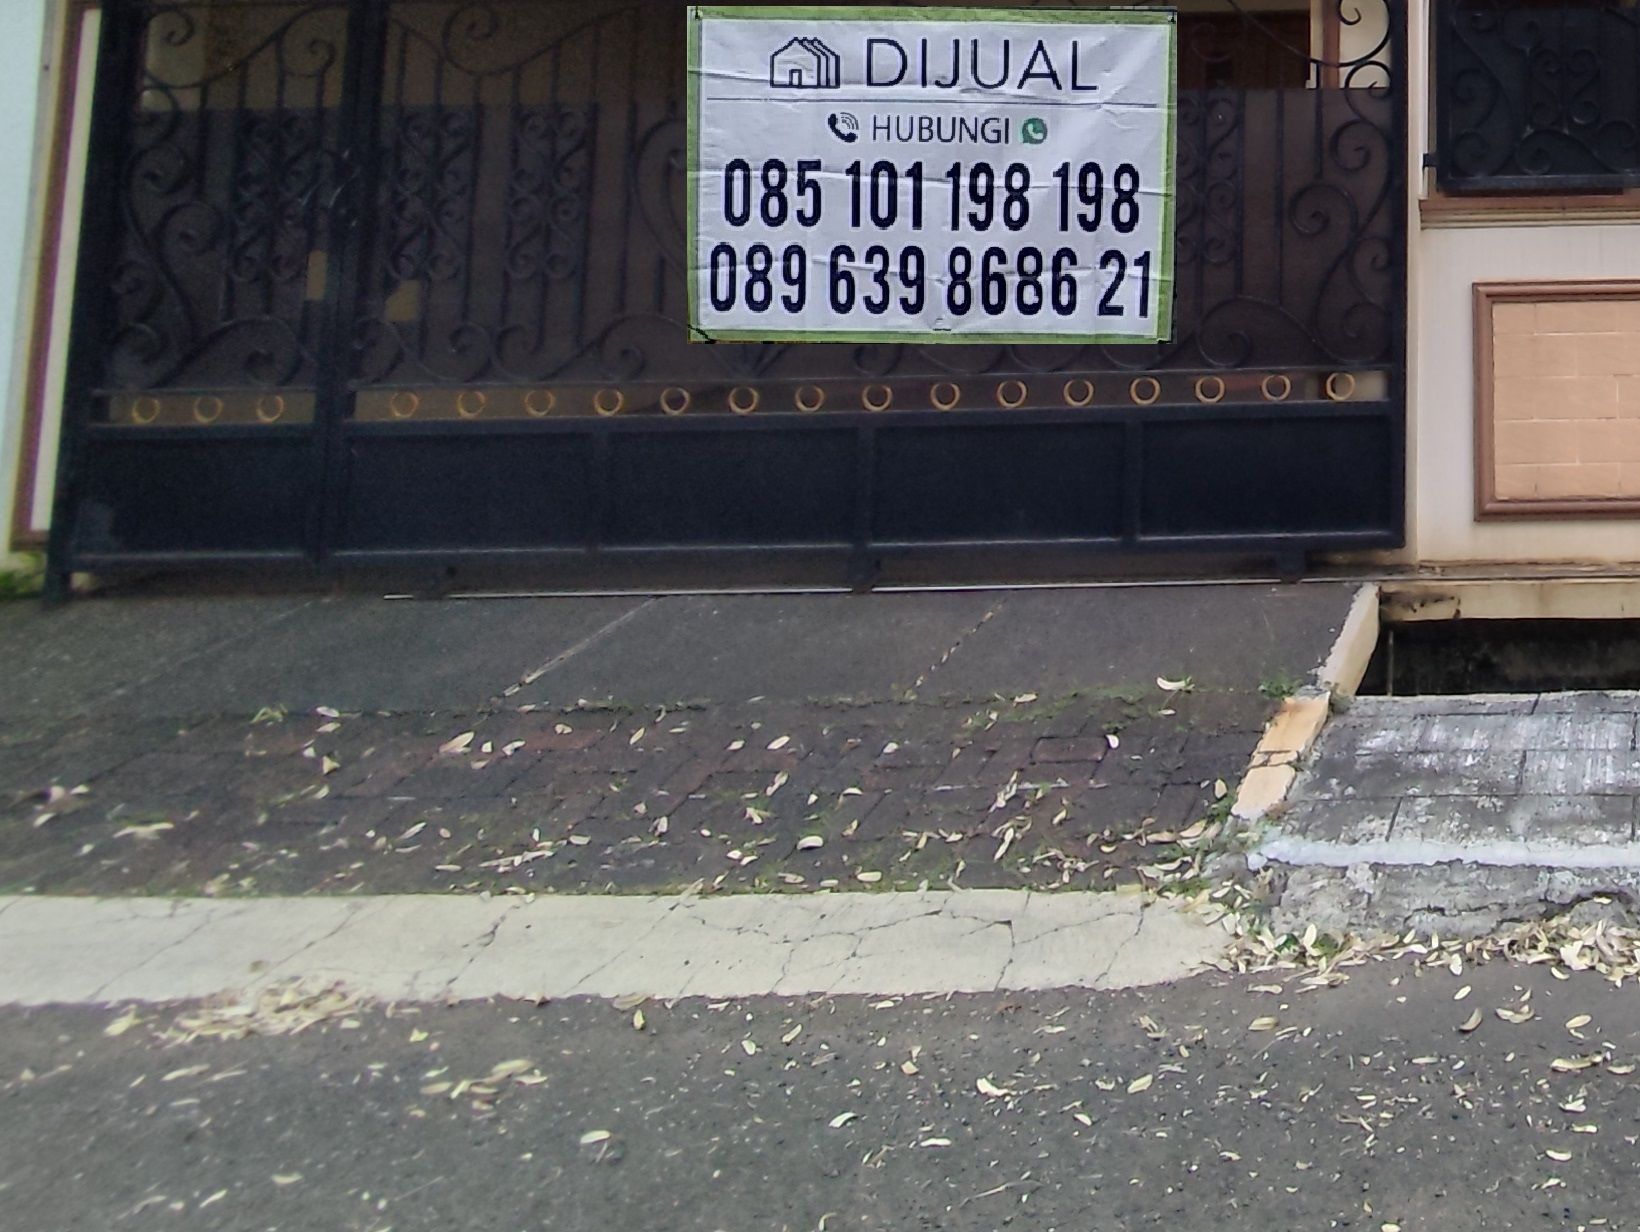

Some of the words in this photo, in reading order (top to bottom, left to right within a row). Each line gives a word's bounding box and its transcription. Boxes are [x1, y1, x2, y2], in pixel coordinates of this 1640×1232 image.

[866, 38, 1098, 91] DIJUAL
[872, 115, 1010, 144] HUBUNGI
[723, 158, 822, 228] 085
[845, 160, 924, 231] 101
[946, 161, 1031, 232] 198
[1053, 161, 1140, 234] 198
[710, 243, 807, 313] 089
[829, 244, 925, 315] 639
[947, 246, 1078, 317] 8686
[1098, 249, 1151, 318] 21
